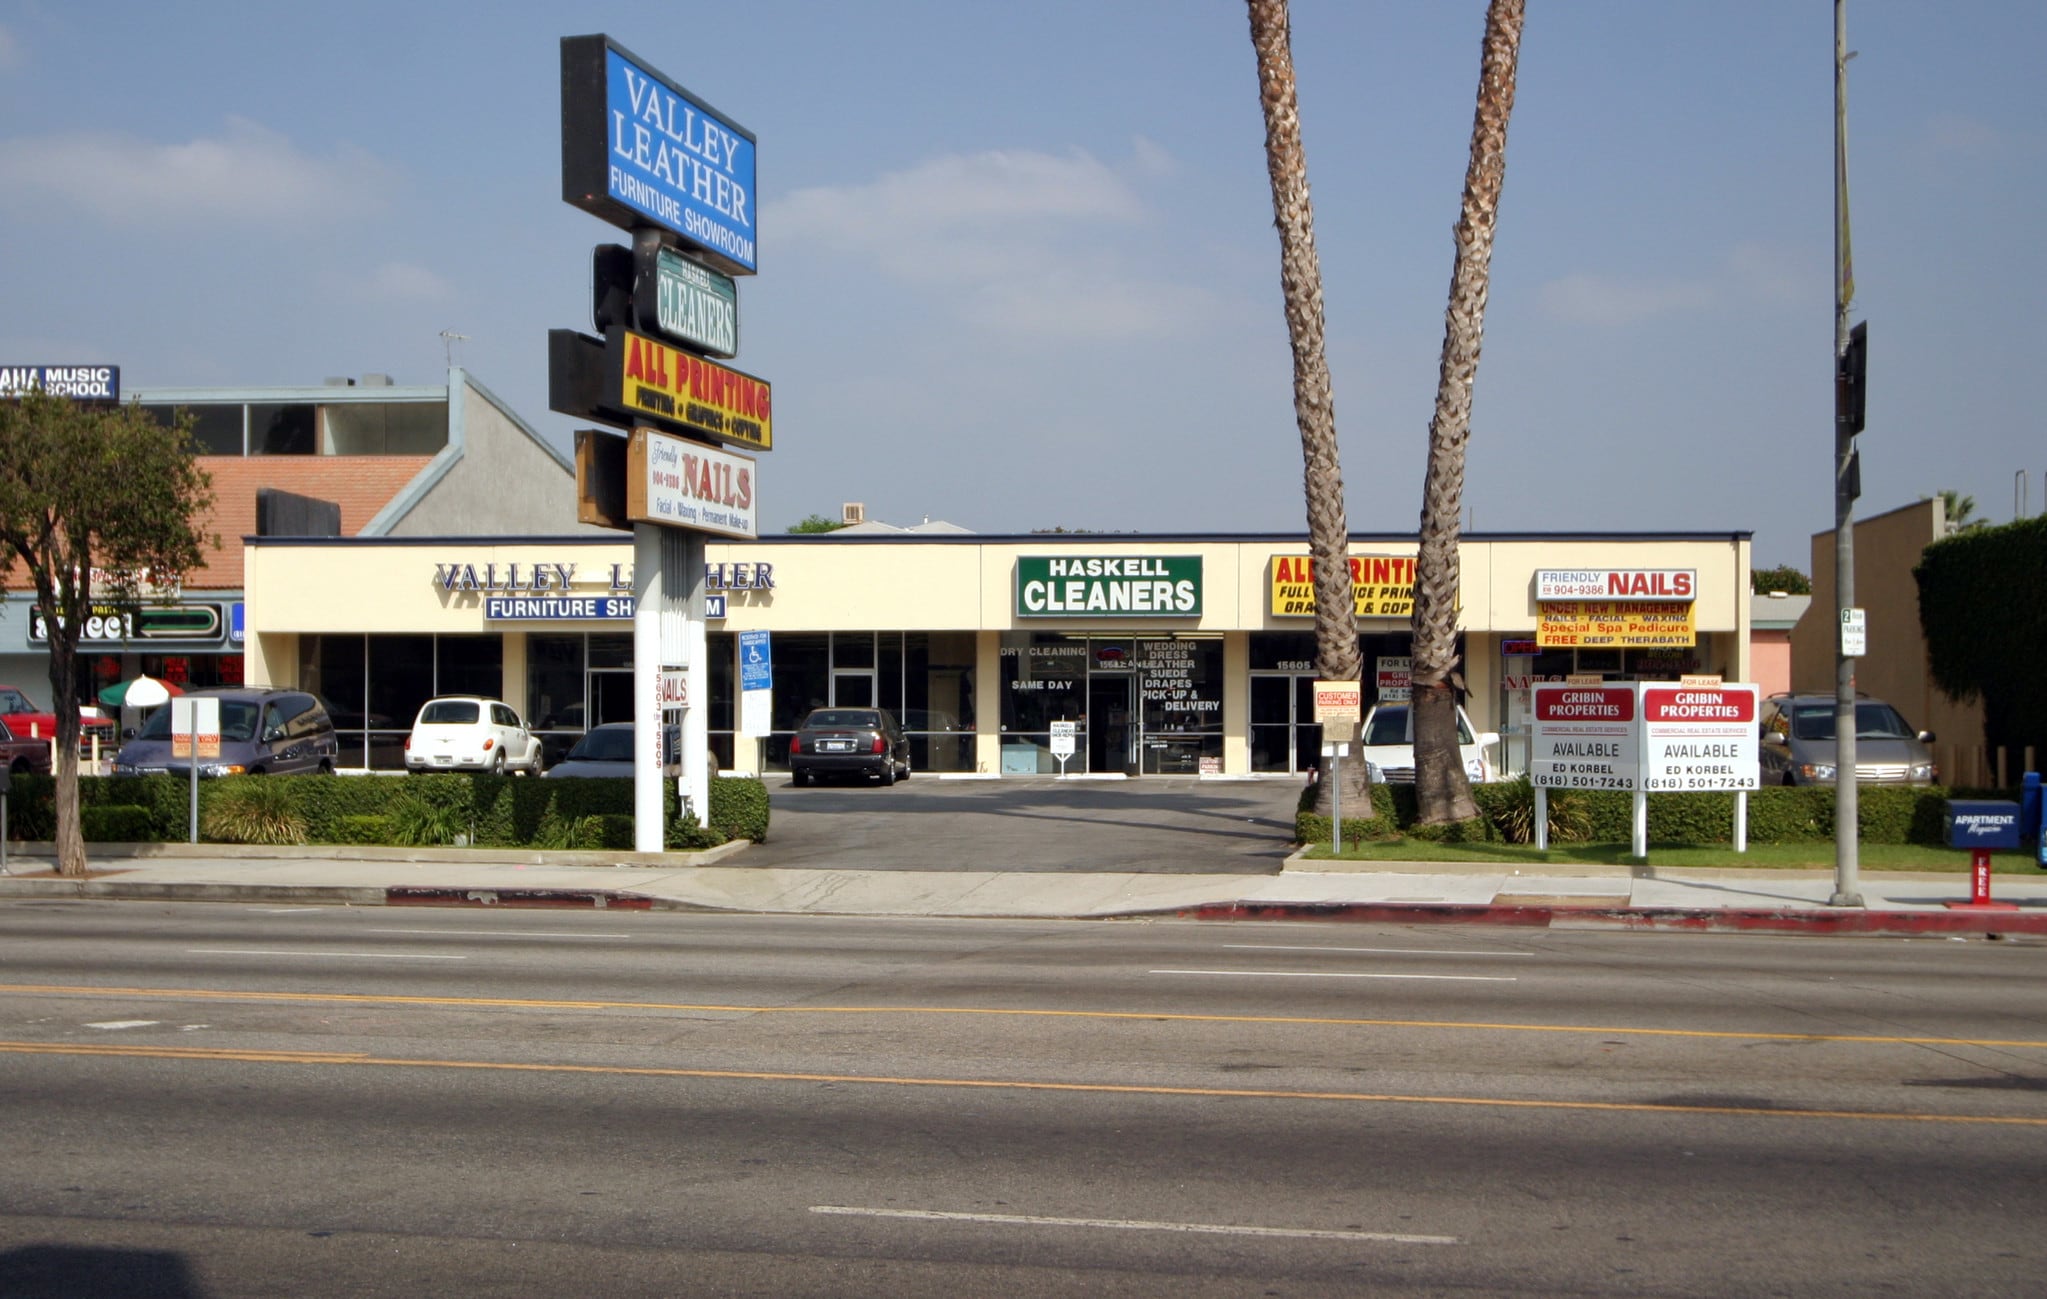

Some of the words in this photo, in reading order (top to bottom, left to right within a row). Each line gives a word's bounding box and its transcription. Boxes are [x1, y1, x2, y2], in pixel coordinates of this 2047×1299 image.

[624, 67, 739, 174] VALLEY
[613, 110, 749, 226] LEATHER
[610, 165, 681, 225] FURNITURE
[685, 208, 753, 263] SHOWROOM
[682, 260, 710, 289] HASKELL
[658, 274, 733, 351] CLEANERS
[45, 368, 110, 381] MUSIC
[626, 336, 667, 388] ALL
[676, 352, 769, 422] PRINTING
[45, 382, 110, 396] SCHOOL
[636, 385, 675, 415] PRINTING
[686, 401, 723, 432] GRAPHICS
[652, 441, 678, 468] Friendly
[682, 453, 751, 510] NAILS
[656, 498, 672, 514] Facial
[678, 502, 697, 523] Waxing
[702, 507, 728, 525] Permanent
[1050, 559, 1169, 577] HASKELL
[434, 562, 578, 591] VALLEY
[1542, 573, 1600, 583] FRIENDLY
[1608, 573, 1691, 596] NAILS
[1554, 585, 1604, 595] 904-9386
[1024, 580, 1195, 612] CLEANERS
[1279, 586, 1309, 599] FULL
[490, 600, 597, 617] FURNITURE
[1364, 603, 1375, 614] &
[1542, 603, 1578, 614] UNDER
[1584, 603, 1609, 614] NEW
[1615, 602, 1690, 614] MANAGEMENT
[1844, 610, 1850, 621] 2
[1542, 623, 1590, 634] Special
[1597, 623, 1622, 634] Spa
[1629, 623, 1689, 633] Pedicure
[1143, 642, 1197, 650] WEDDING
[1545, 635, 1578, 645] FREE
[1584, 636, 1614, 644] DEEP
[1622, 636, 1690, 644] THERABATH
[1000, 647, 1024, 656] DRY
[1029, 647, 1086, 656] CLEANING
[1149, 651, 1188, 659] DRESS
[1142, 660, 1195, 668] LEATHER
[1277, 661, 1311, 670] 15605
[1150, 669, 1188, 678] SUEDE
[1012, 681, 1044, 690] SAME
[1048, 681, 1073, 690] DAY
[1145, 679, 1192, 688] DRAPES
[1142, 690, 1187, 699] PICK-UP
[1191, 690, 1198, 699] &
[1318, 692, 1358, 700] CUSTOMER
[1562, 692, 1605, 703] GRIBIN
[1675, 692, 1723, 705] GRIBIN
[1165, 701, 1220, 711] DELIVERY
[1549, 705, 1620, 716] PROPERTIES
[1660, 705, 1739, 717] PROPERTIES
[1553, 742, 1619, 757] AVAILABLE
[1664, 744, 1738, 758] AVAILABLE
[1552, 763, 1566, 773] ED
[1570, 764, 1614, 774] KORBEL
[1666, 766, 1681, 775] ED
[1686, 765, 1734, 775] KORBEL
[1535, 774, 1568, 786] (818)
[1572, 776, 1633, 789] 501-7243
[1644, 776, 1683, 790] (818)
[1688, 777, 1755, 789] 501-7243
[1955, 815, 2015, 824] APARTMENT
